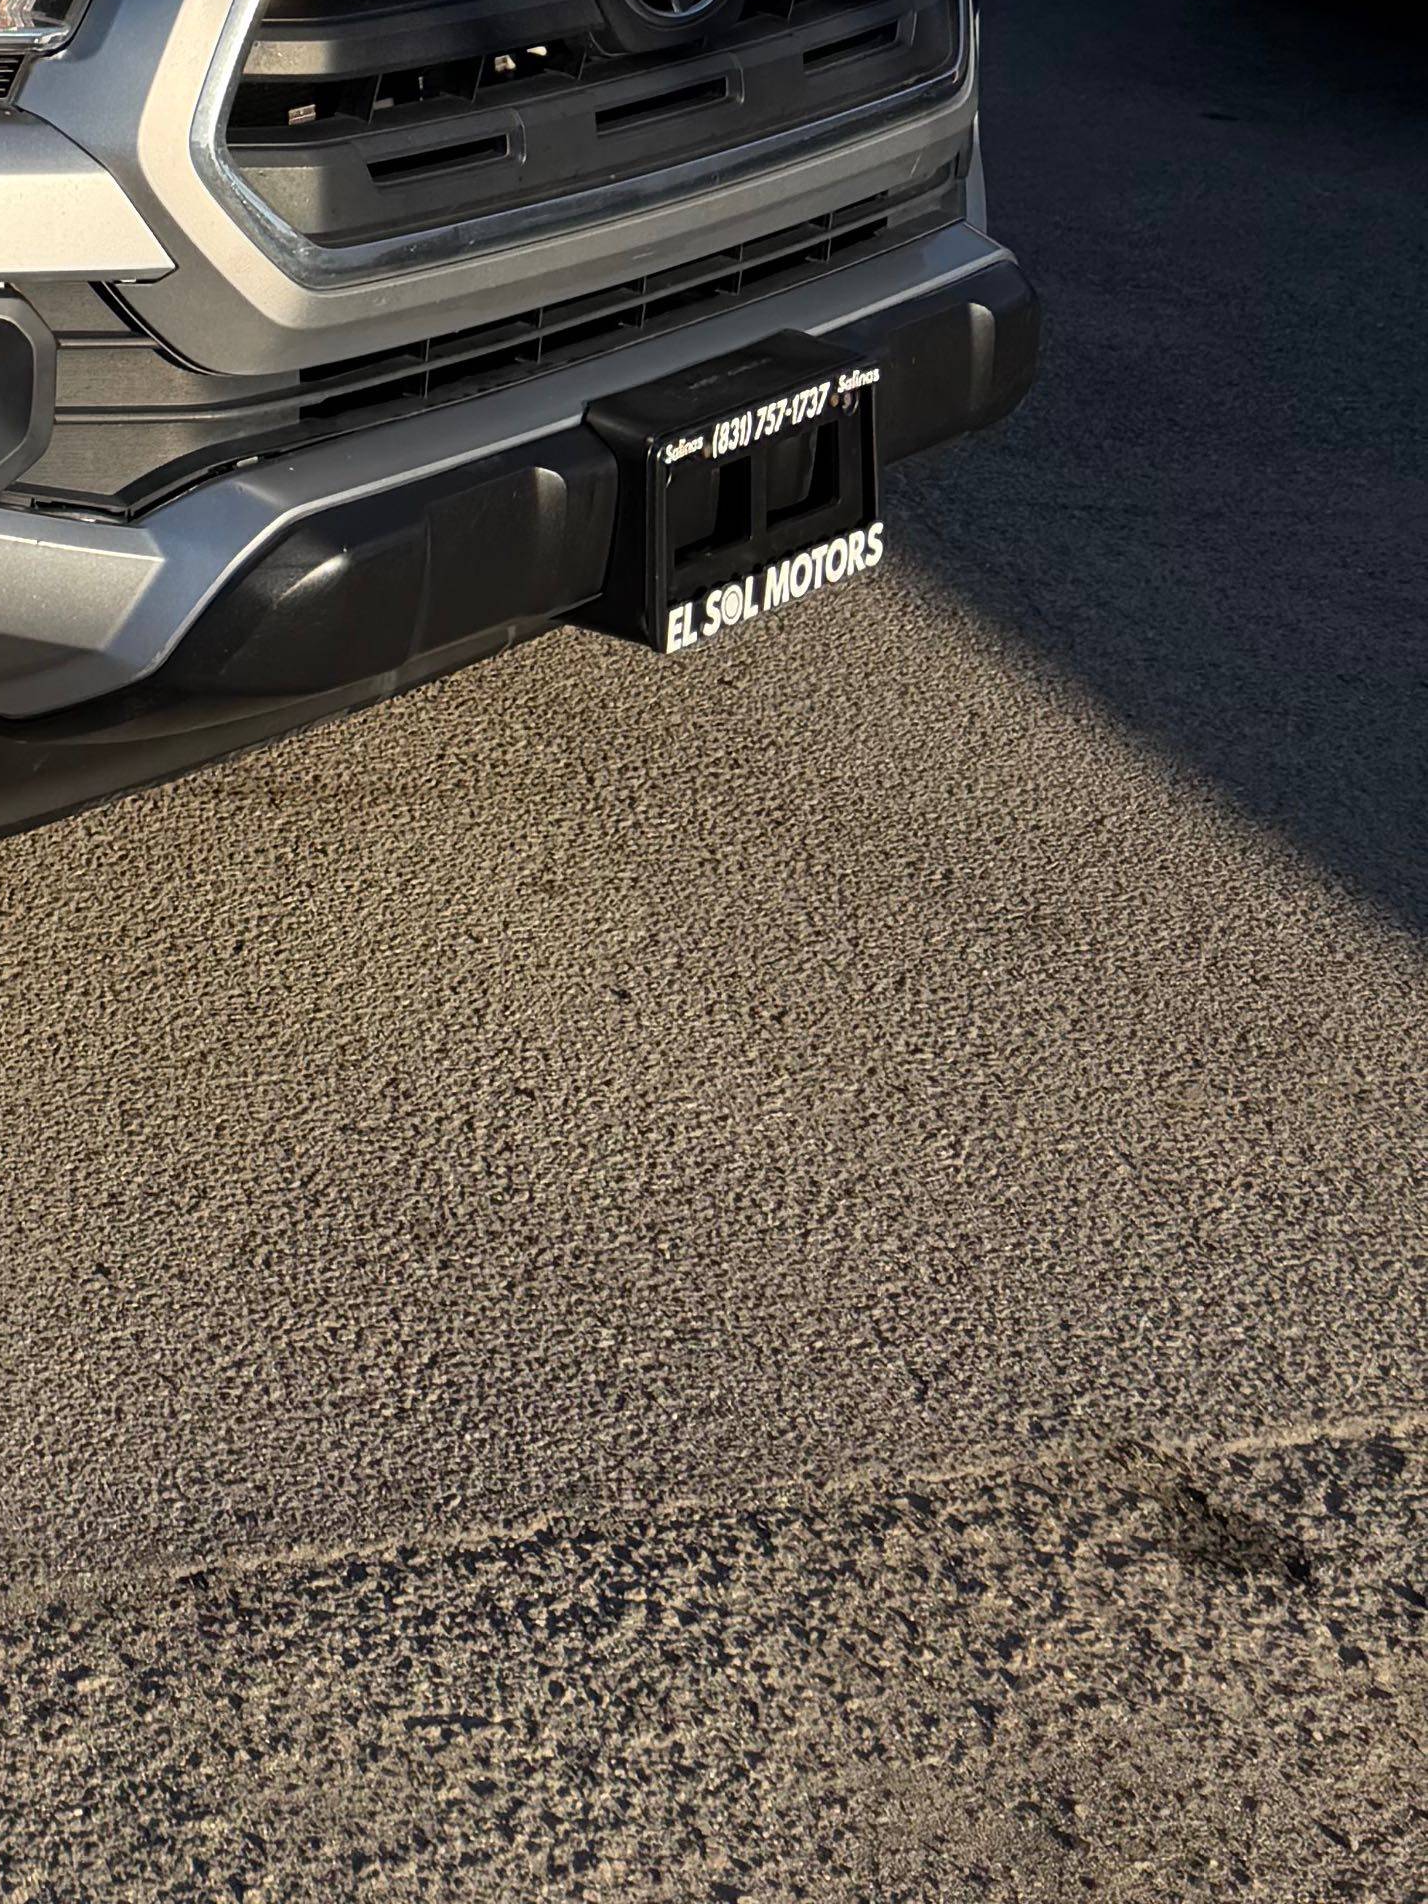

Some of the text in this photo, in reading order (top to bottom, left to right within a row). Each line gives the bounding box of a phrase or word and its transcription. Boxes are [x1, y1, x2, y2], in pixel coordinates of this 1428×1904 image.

[664, 368, 880, 464] Salinas (831) 757-1737 Salinas
[665, 522, 884, 654] EL SOL MOTORS
